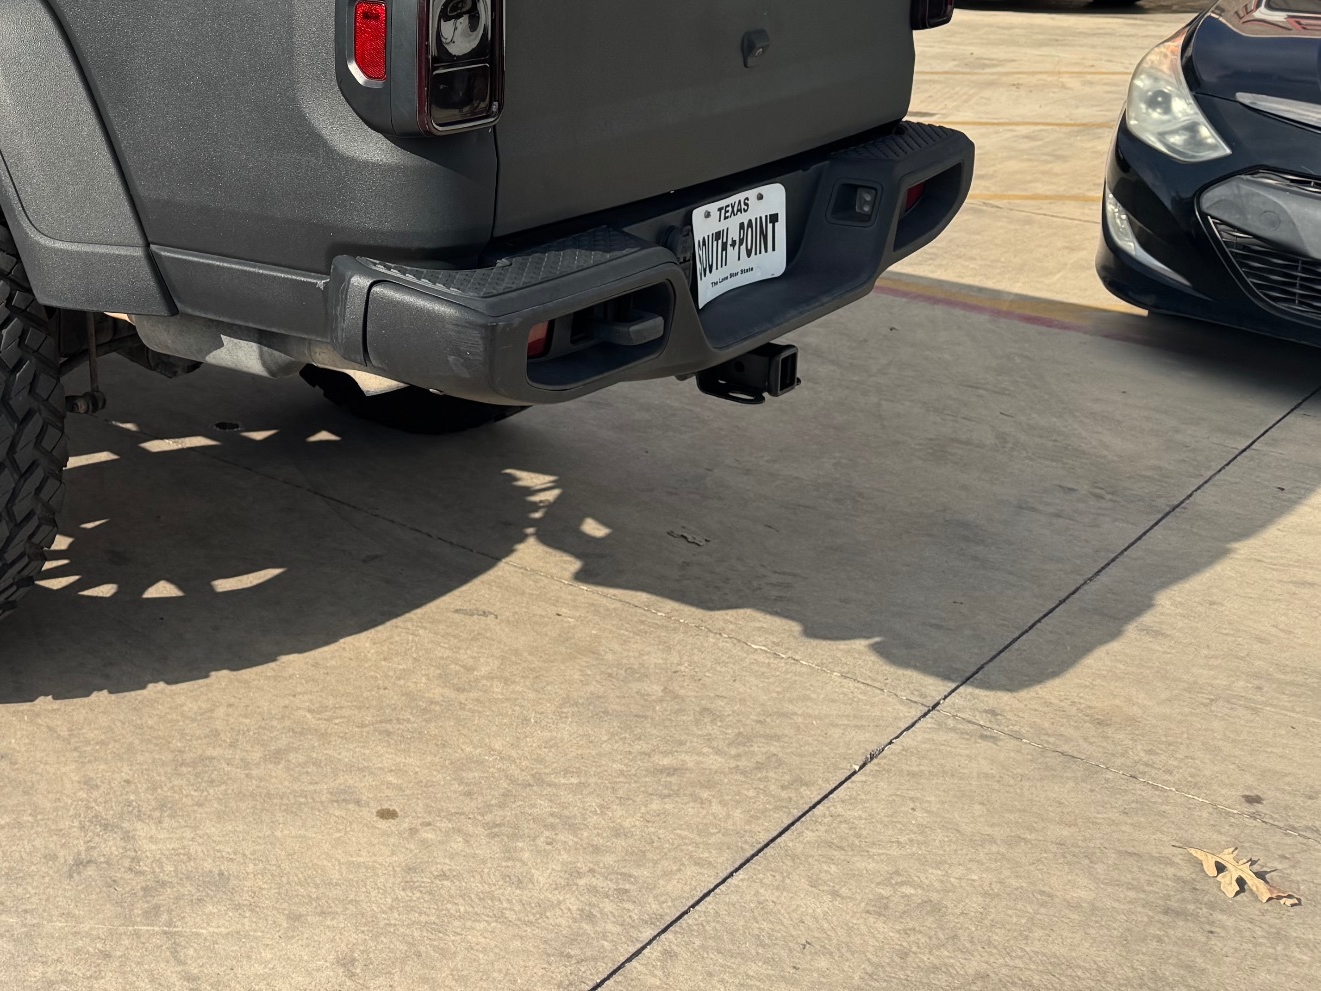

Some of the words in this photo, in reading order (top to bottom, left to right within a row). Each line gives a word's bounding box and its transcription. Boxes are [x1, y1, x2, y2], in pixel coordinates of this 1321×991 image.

[717, 197, 750, 222] TEXAS
[698, 228, 729, 281] SOUTH
[738, 213, 779, 261] POINT
[719, 275, 729, 284] Lone
[729, 270, 739, 279] Star
[740, 266, 754, 275] State
